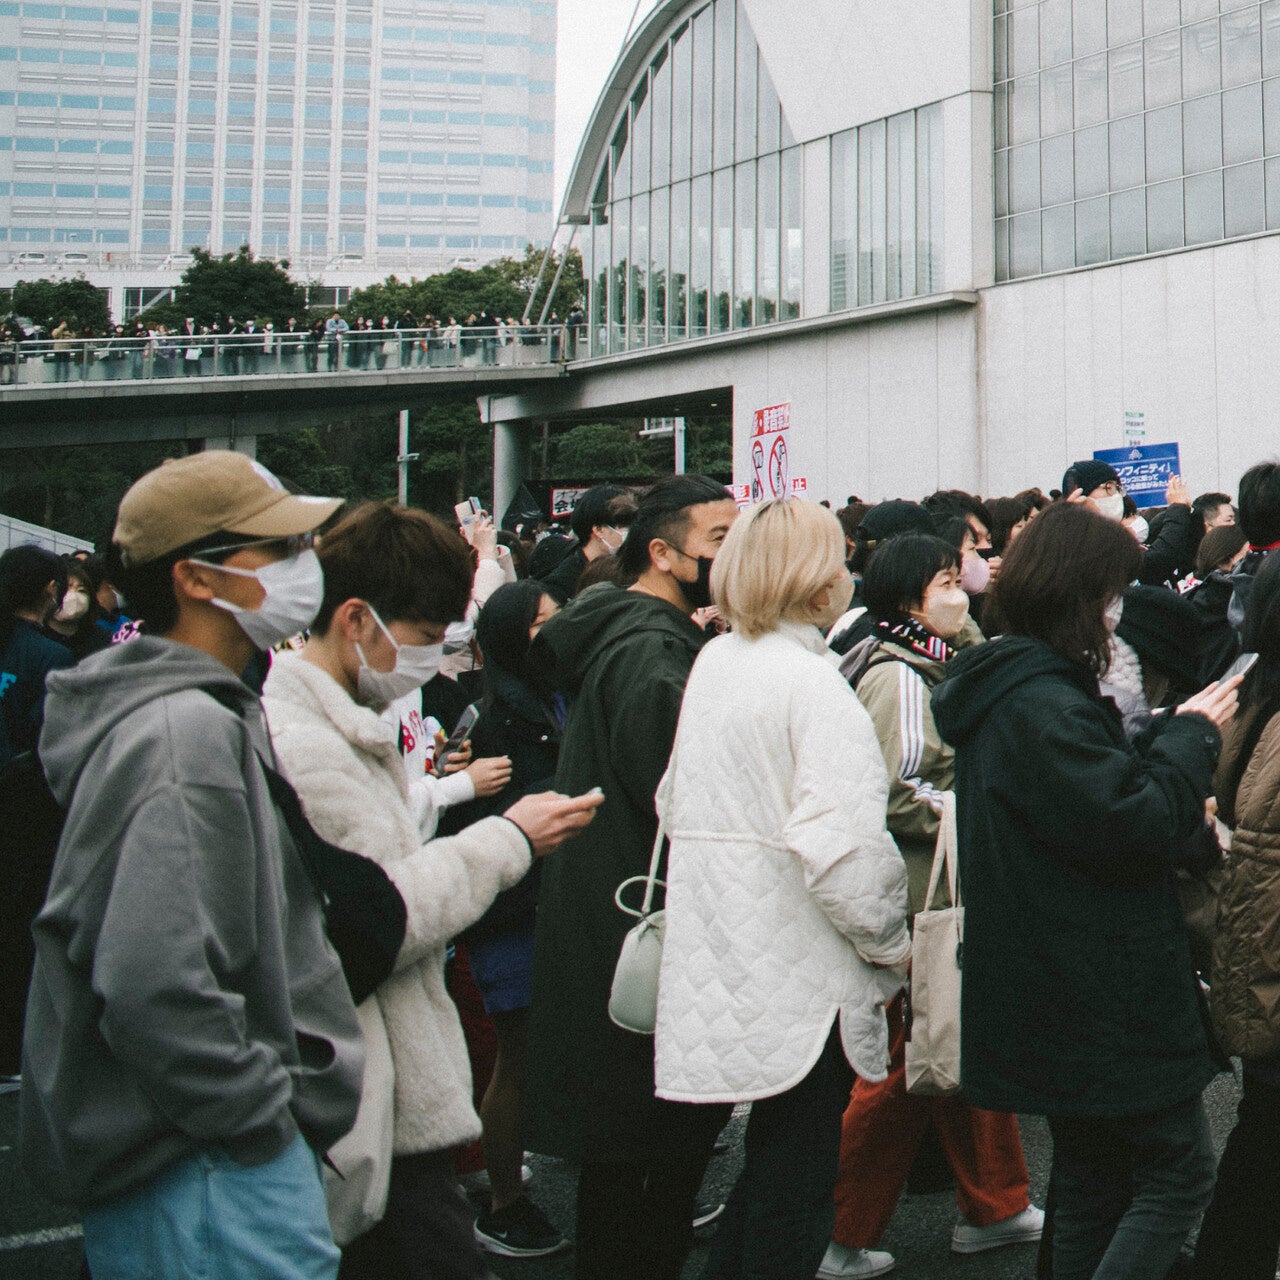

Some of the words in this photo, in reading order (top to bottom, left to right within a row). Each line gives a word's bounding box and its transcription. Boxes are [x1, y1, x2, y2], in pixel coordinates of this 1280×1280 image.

[1115, 462, 1171, 477] ンフィニティ」
